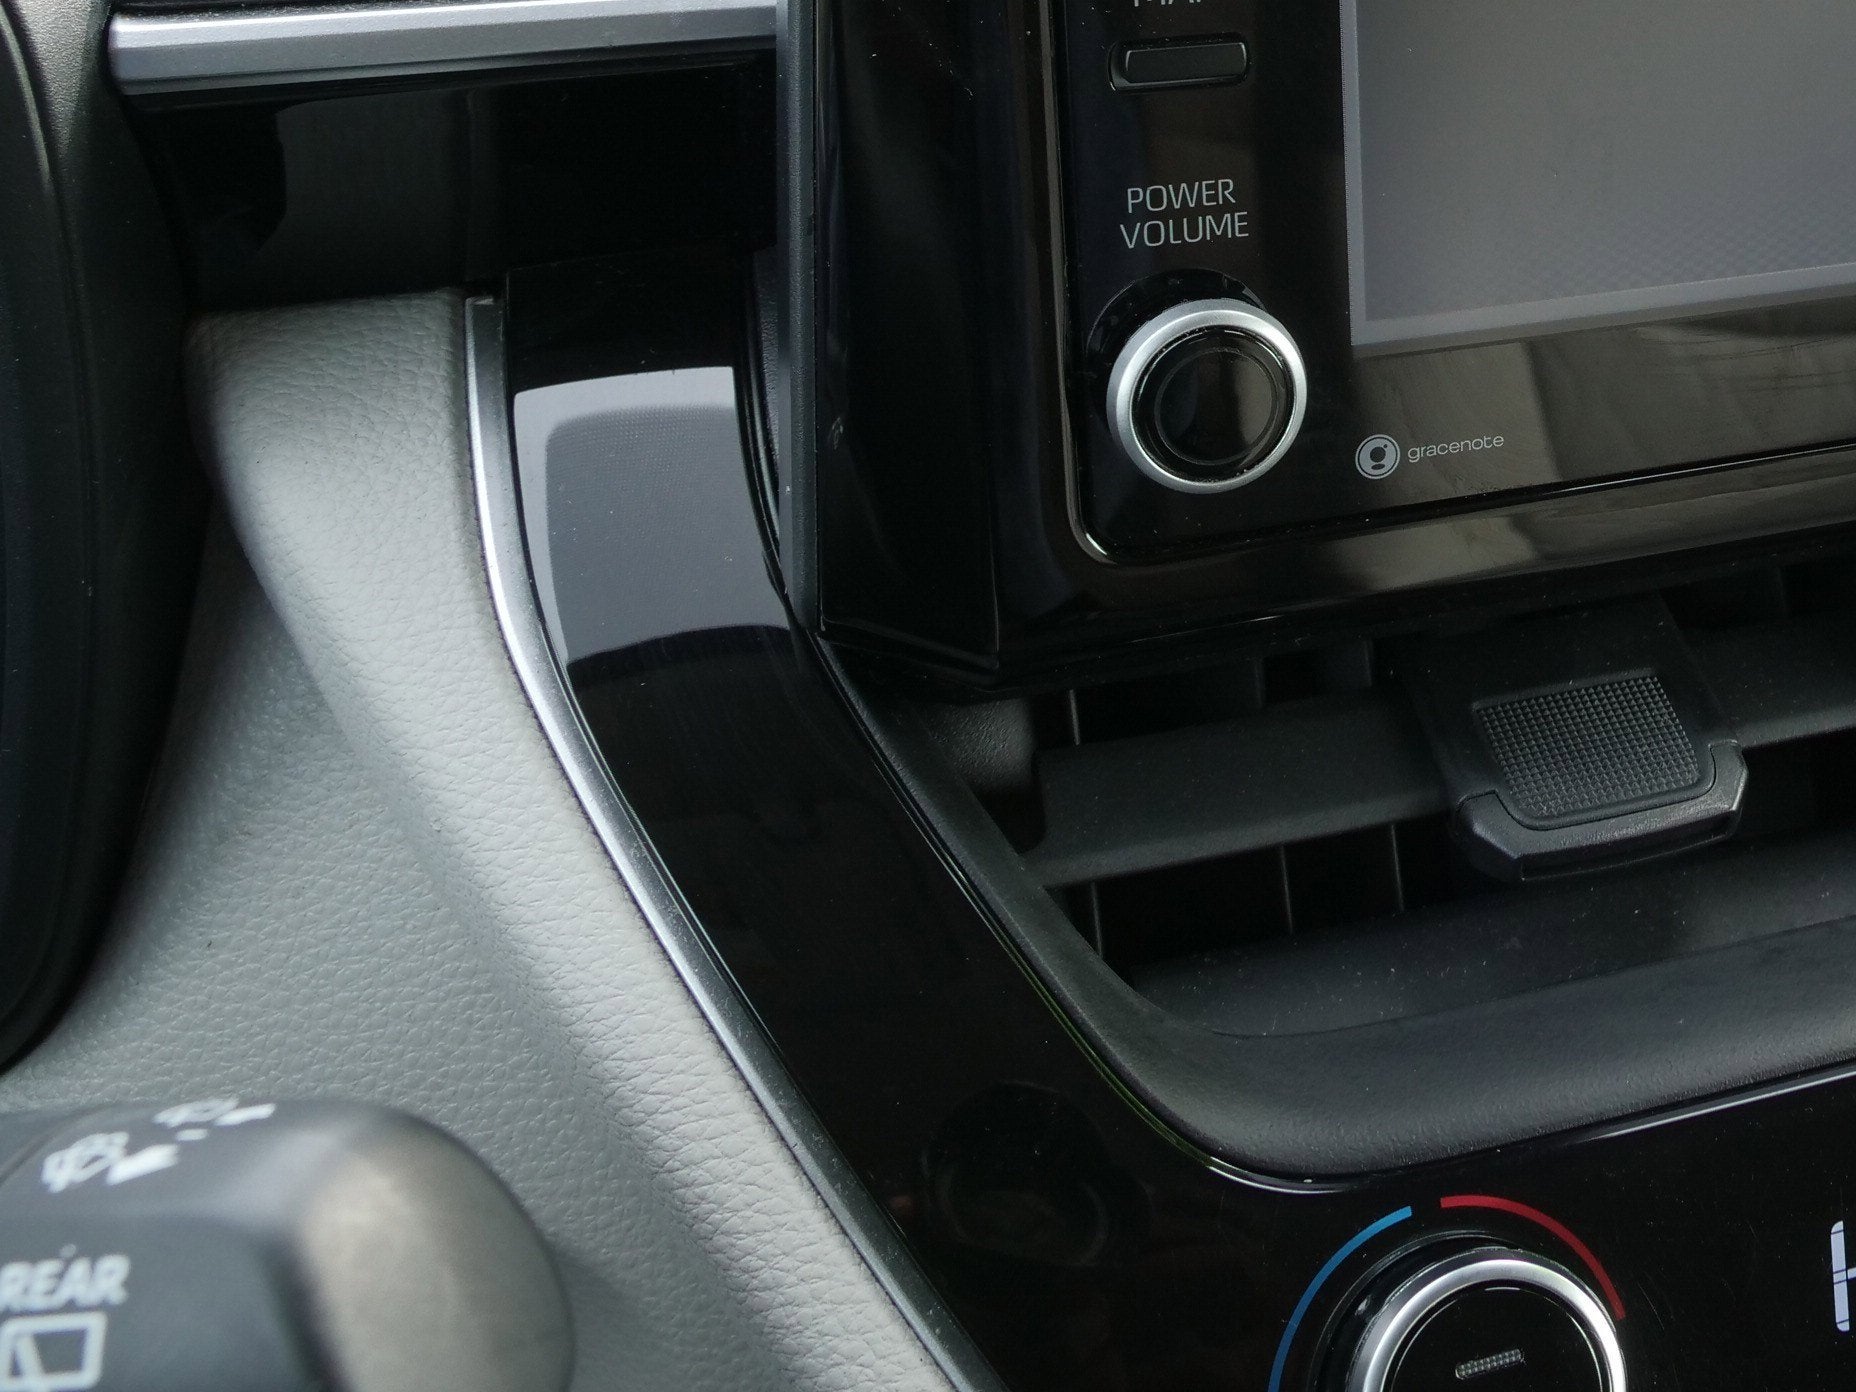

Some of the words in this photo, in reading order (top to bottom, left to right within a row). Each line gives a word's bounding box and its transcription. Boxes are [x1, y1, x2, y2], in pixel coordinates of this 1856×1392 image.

[1126, 177, 1237, 214] POWER
[1119, 211, 1250, 250] VOLUME
[1406, 432, 1505, 463] gracenote
[0, 1254, 131, 1311] REAR
